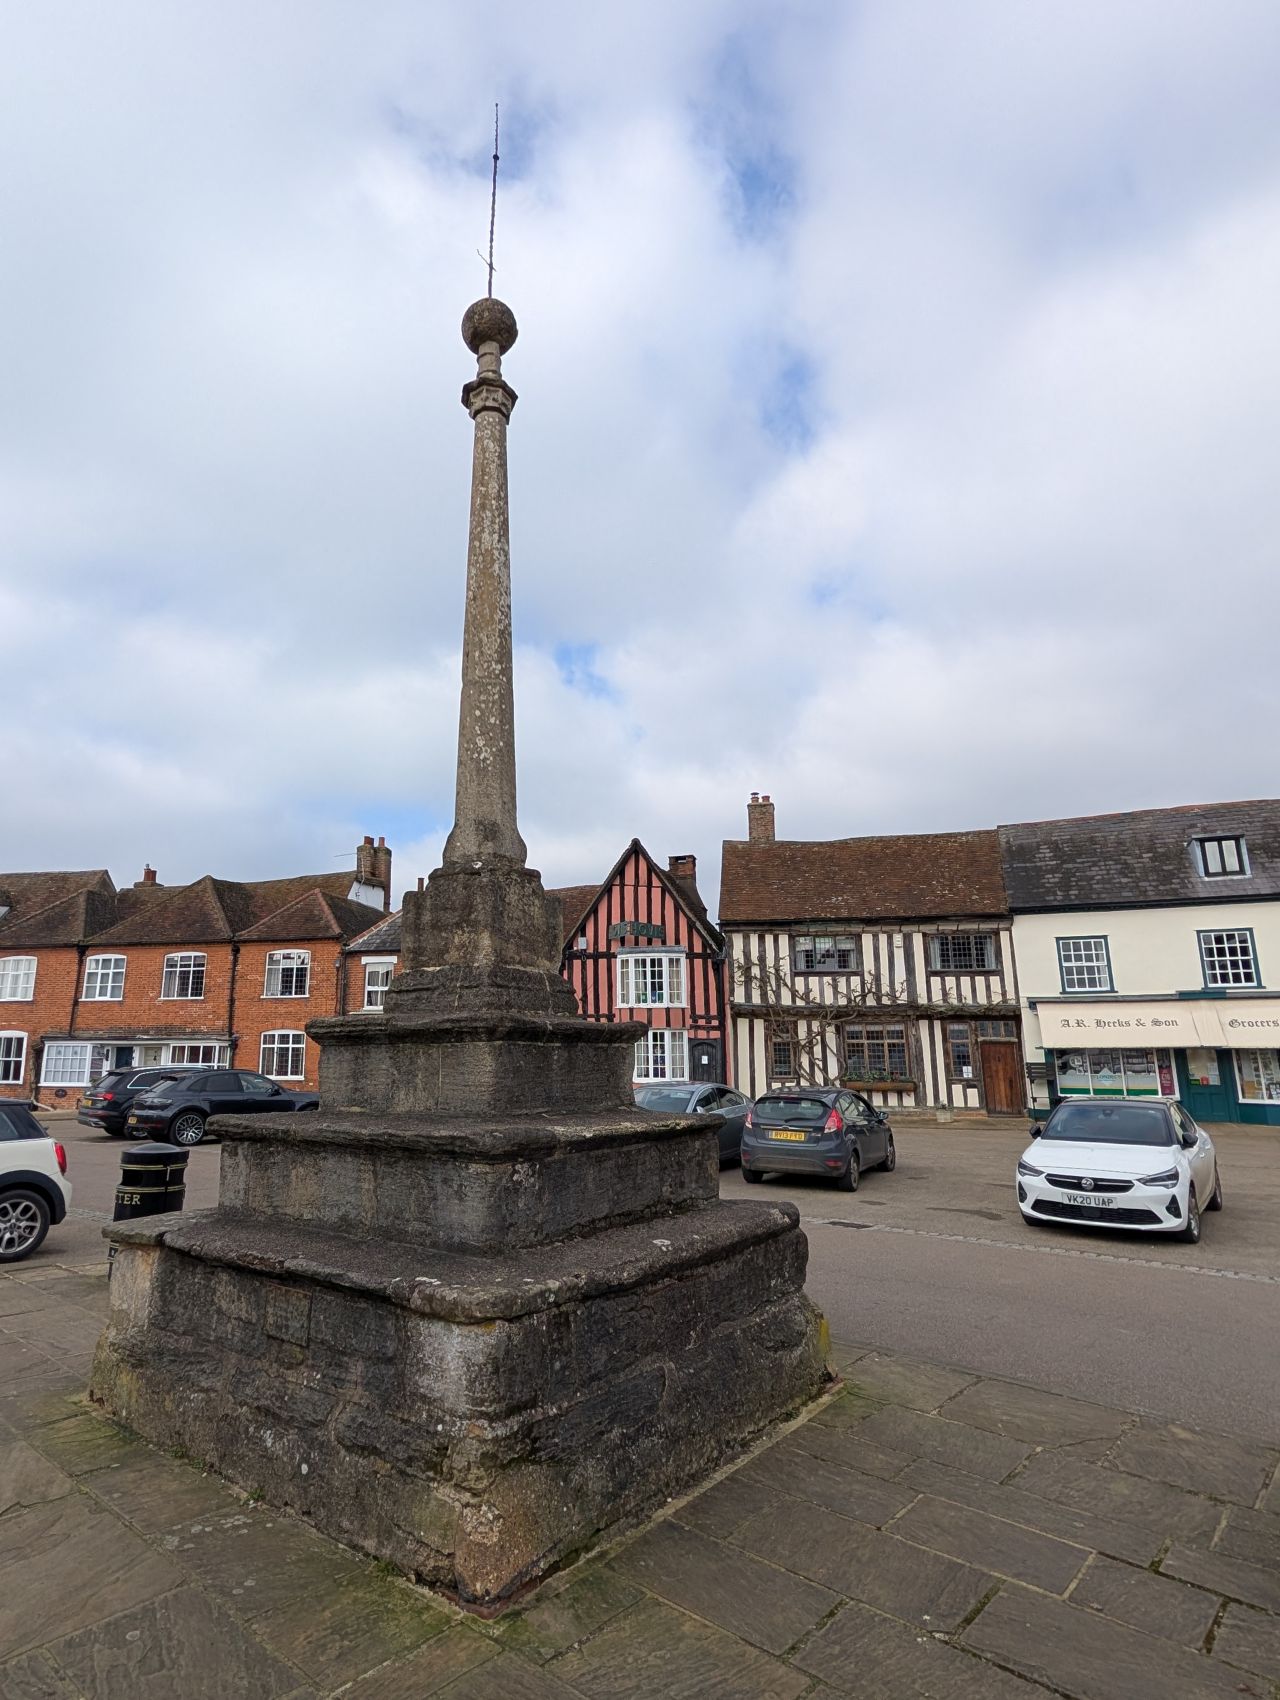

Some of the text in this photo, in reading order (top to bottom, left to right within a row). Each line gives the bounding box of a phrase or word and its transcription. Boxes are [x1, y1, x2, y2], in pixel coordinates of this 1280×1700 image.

[1060, 1018, 1090, 1028] A.R.
[1135, 1018, 1147, 1027] &
[1151, 1017, 1179, 1027] Son
[1066, 1194, 1113, 1207] VK20 UAP
